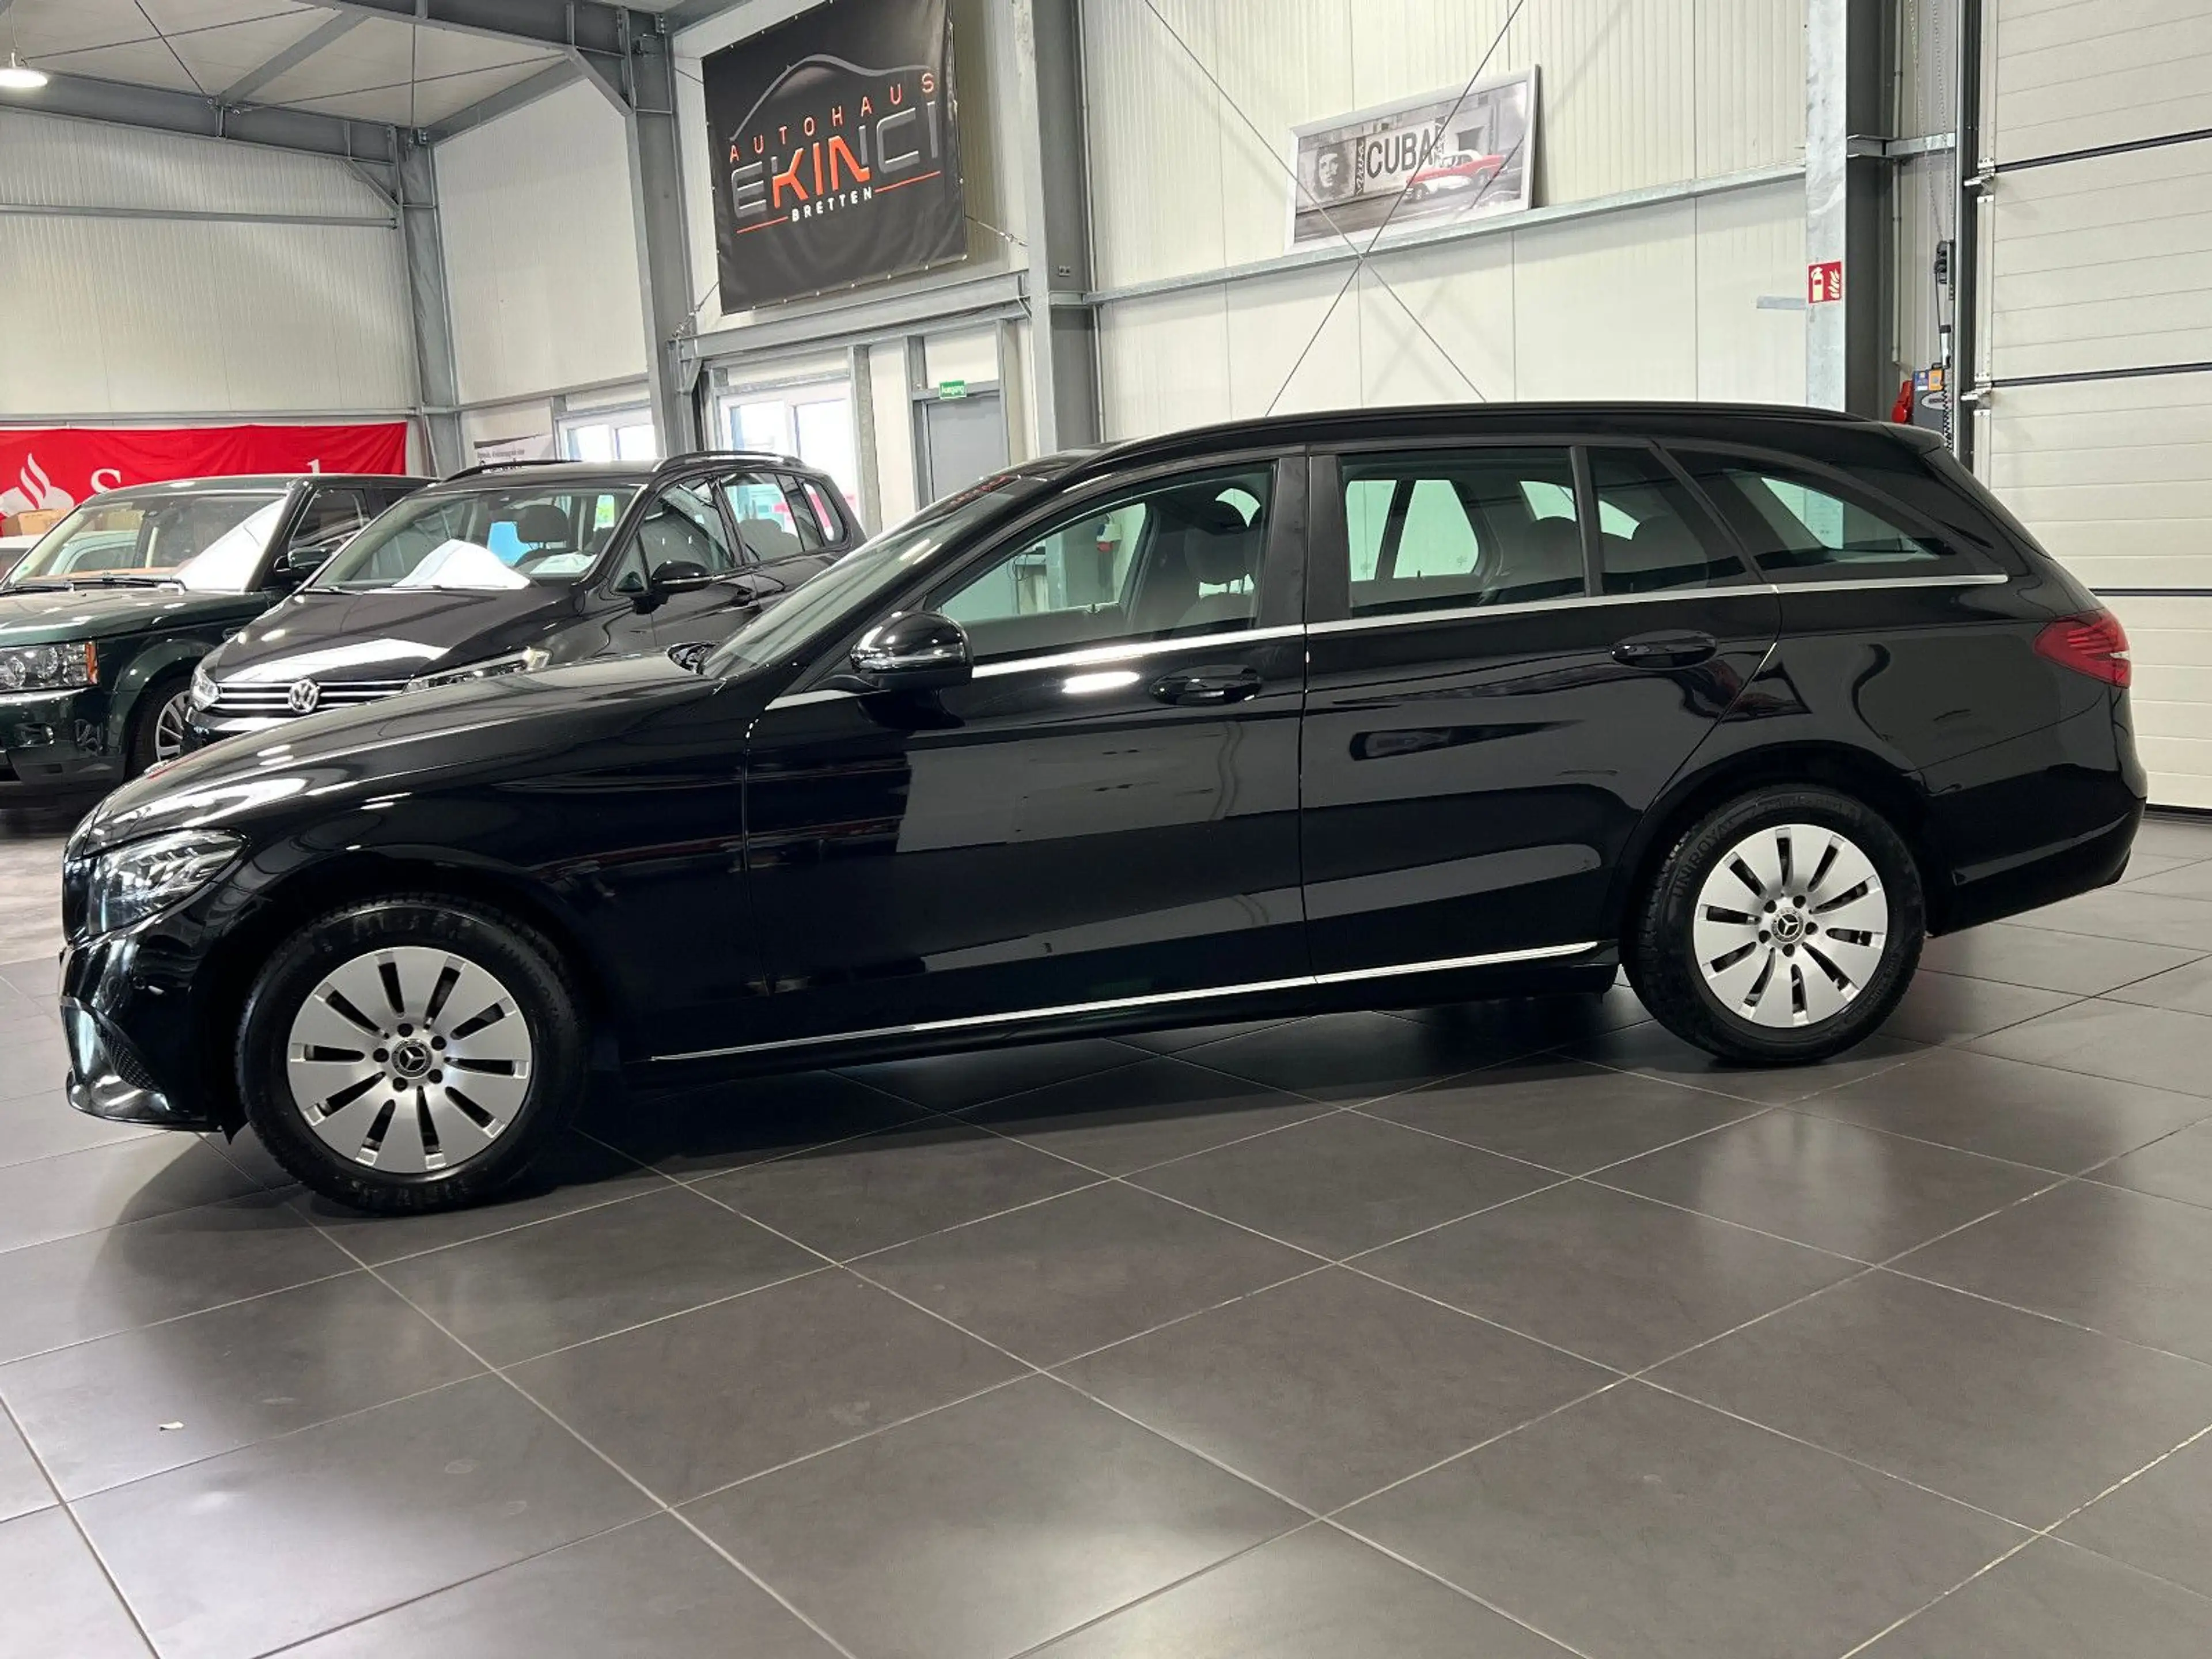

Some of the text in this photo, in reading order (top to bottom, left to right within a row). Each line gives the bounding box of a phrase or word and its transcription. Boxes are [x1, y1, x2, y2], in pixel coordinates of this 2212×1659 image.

[730, 72, 935, 163] AUTOHAUS
[1366, 128, 1433, 179] CUBA
[791, 186, 873, 222] BRETTEN
